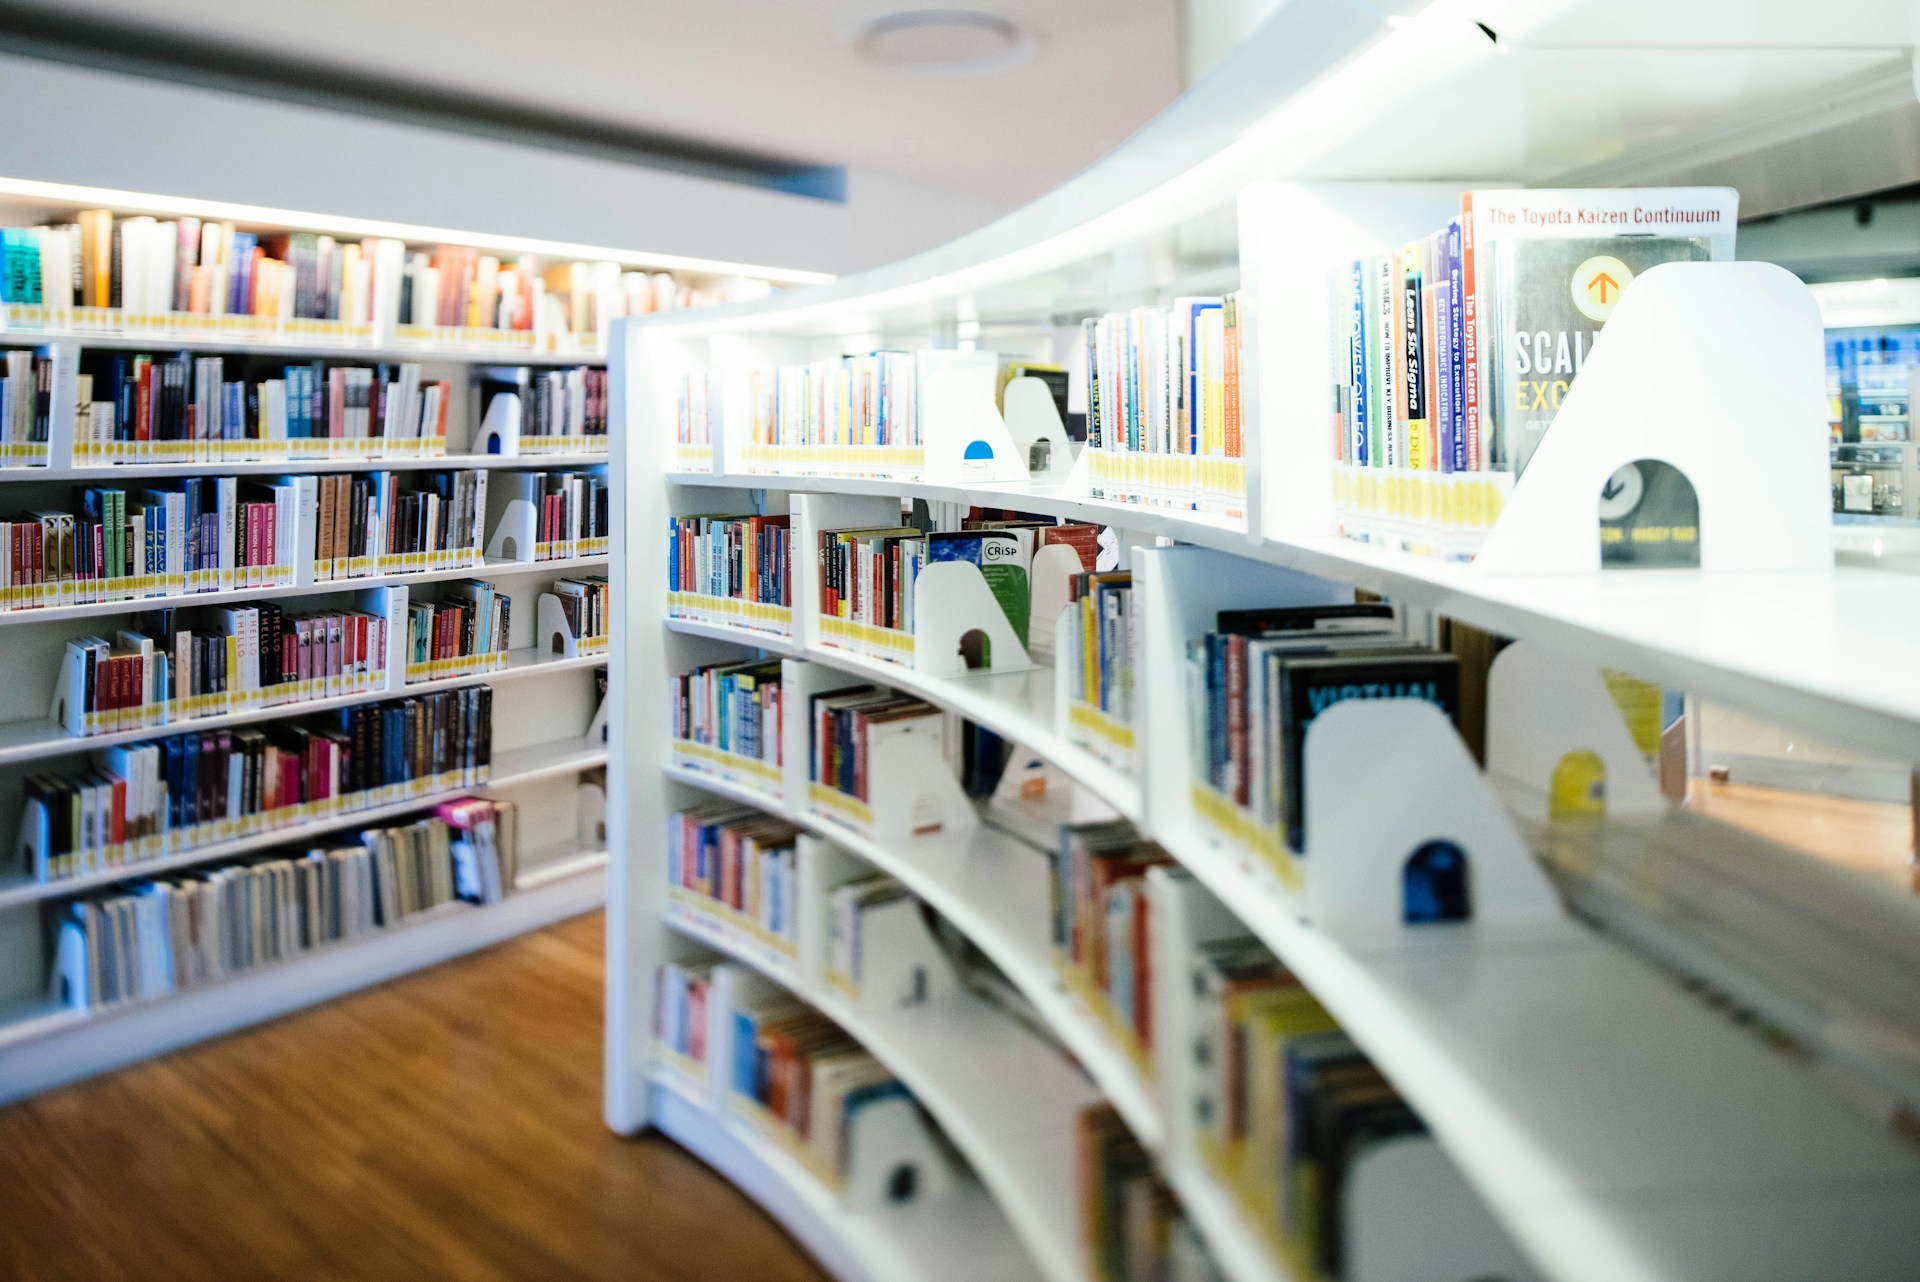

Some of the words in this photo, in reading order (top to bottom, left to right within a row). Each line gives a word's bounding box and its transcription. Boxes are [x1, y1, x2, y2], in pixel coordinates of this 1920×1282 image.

[1490, 208, 1516, 224] The
[1522, 208, 1571, 228] Toyota
[1577, 207, 1628, 224] Kaizen
[1633, 206, 1721, 223] Continuum
[1451, 270, 1459, 305] Driving
[1406, 289, 1418, 330] Lean
[1438, 298, 1446, 313] KEY
[1466, 294, 1475, 318] The
[1353, 310, 1361, 376] POWER
[1407, 332, 1419, 356] Six
[1439, 315, 1447, 373] PERFORMANCE
[1451, 307, 1460, 349] Strategy
[1465, 320, 1476, 358] Toyota
[1454, 352, 1460, 362] to
[1515, 330, 1599, 374] SCAL
[1408, 359, 1420, 410] Sigma
[1440, 375, 1448, 422] INDICATORS
[1454, 365, 1462, 413] Execution
[1467, 363, 1477, 402] Kaizen
[1516, 380, 1568, 410] EXC
[1454, 415, 1462, 442] Using
[1468, 407, 1479, 470] Continuum
[1525, 420, 1552, 430] GET
[1455, 444, 1463, 468] Lean
[819, 548, 824, 566] WE
[988, 547, 1016, 556] CRiSP
[261, 618, 269, 654] HELLO
